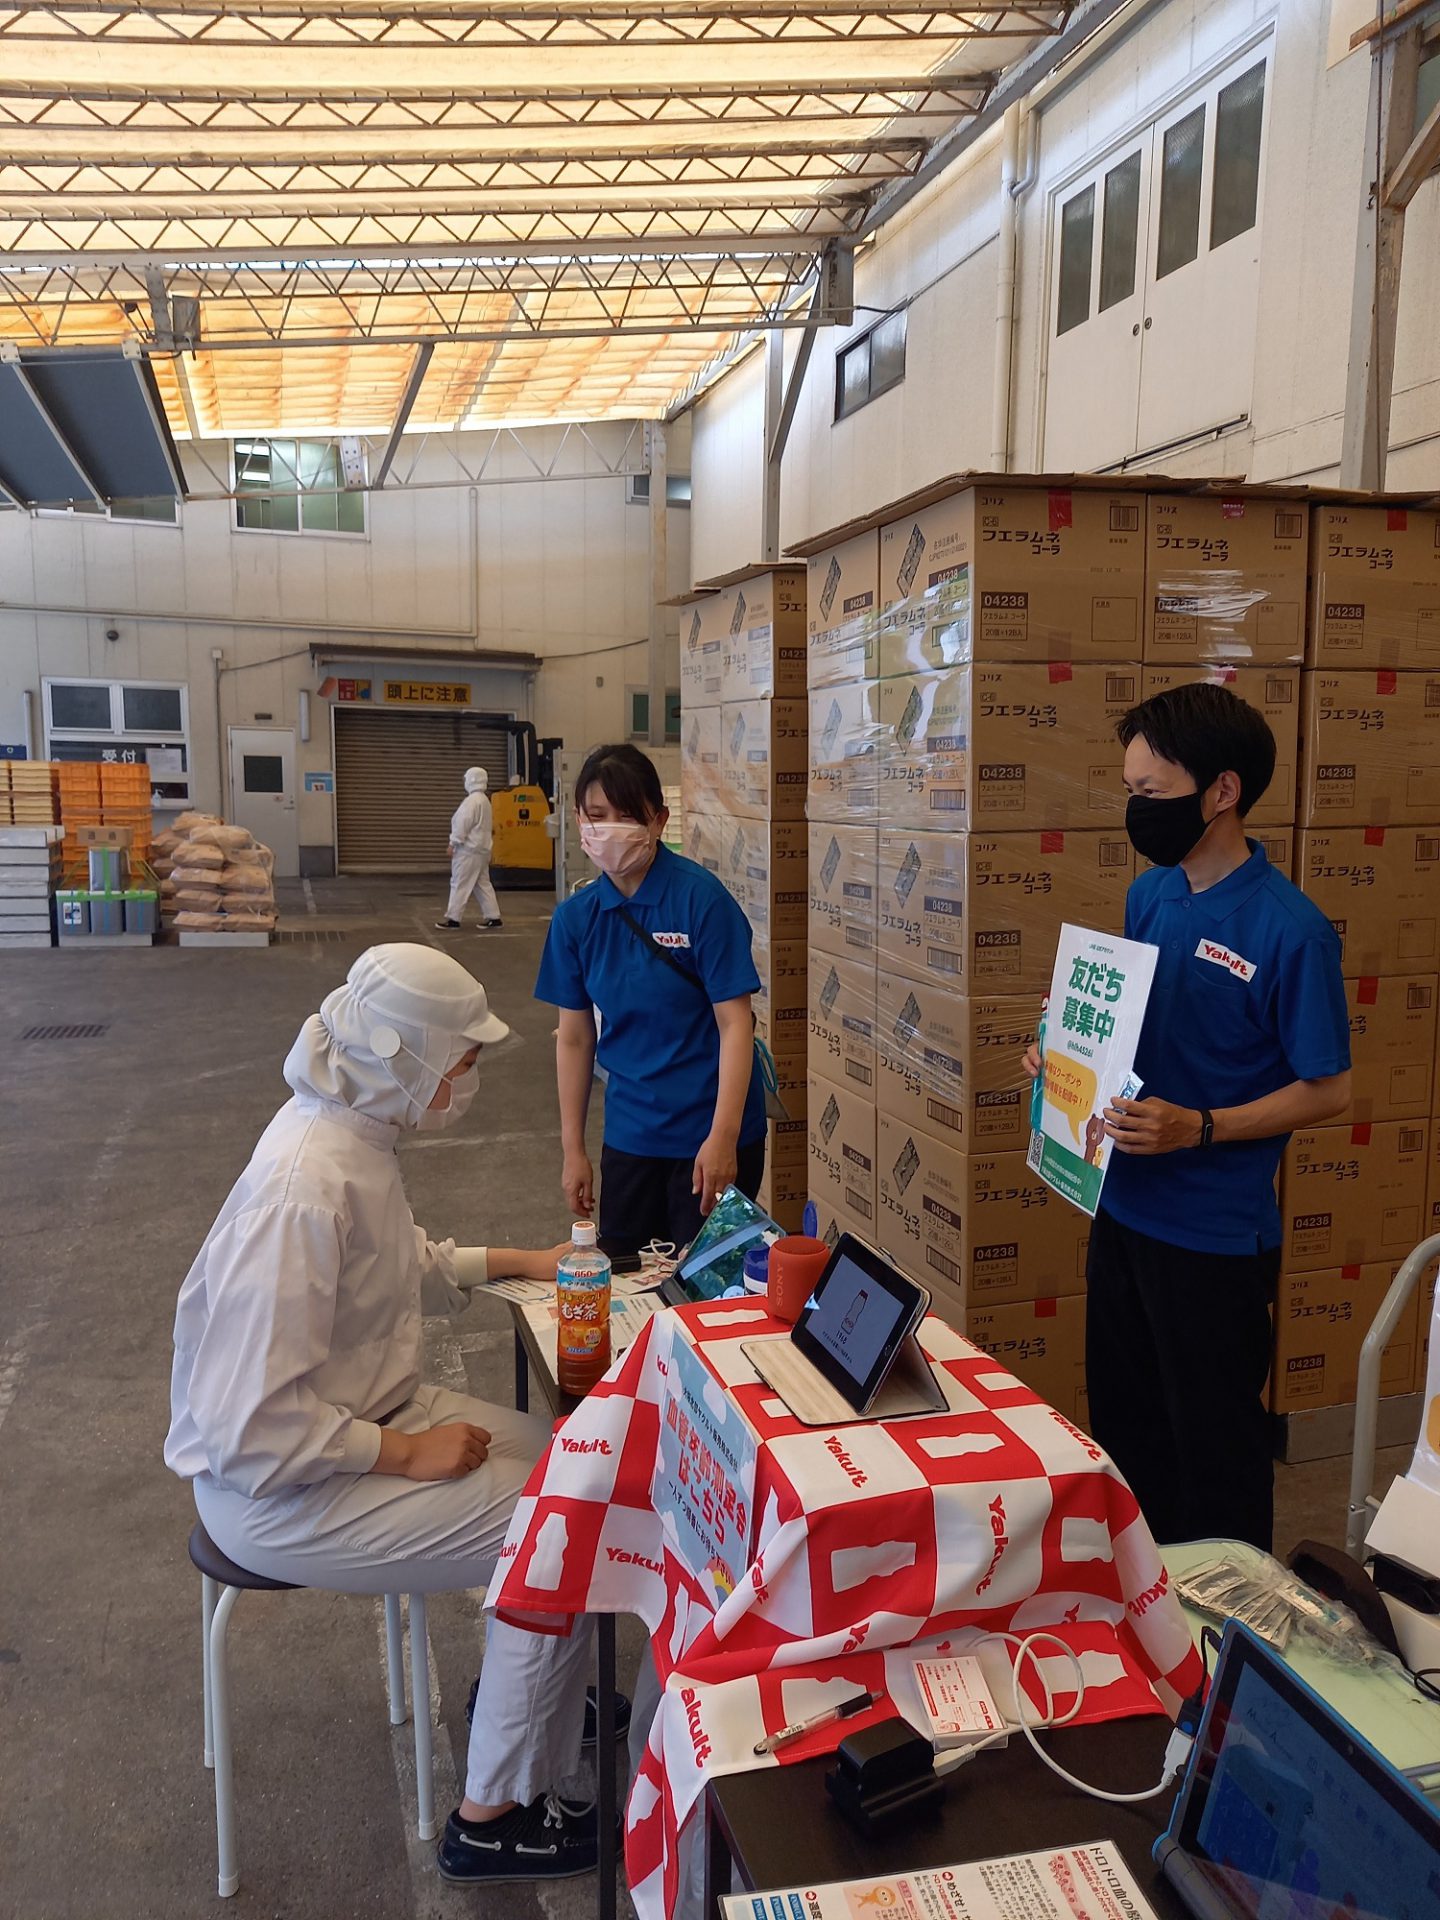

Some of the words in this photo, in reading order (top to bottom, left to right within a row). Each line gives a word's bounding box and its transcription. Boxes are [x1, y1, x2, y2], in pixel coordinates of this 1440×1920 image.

[981, 497, 1004, 506] コリス
[1156, 506, 1177, 514] コリス
[1328, 515, 1349, 524] コリス
[982, 530, 1060, 543] フエラムネ
[1031, 545, 1061, 555] コーラ
[1157, 538, 1229, 550] フエラムネ
[1202, 552, 1229, 561] コーラ
[1328, 546, 1393, 559] フエラムネ
[1369, 559, 1393, 569] コーラ
[984, 594, 1025, 607] 04238
[884, 607, 926, 627] フエラムネ
[1010, 612, 1026, 620] コーラ
[1327, 606, 1362, 617] 04238
[909, 623, 926, 636] コーラ
[810, 629, 841, 646] フエラムネ
[979, 674, 1002, 682] コリス
[1150, 676, 1171, 684] コリス
[387, 684, 468, 703] 頭上に注意
[980, 705, 1057, 716] フエラムネ
[1319, 709, 1384, 720] フエラムネ
[1029, 717, 1057, 727] コーラ
[1360, 721, 1384, 730] コーラ
[102, 749, 136, 763] 受付
[811, 769, 842, 780] フエラムネ
[883, 768, 924, 780] フエラムネ
[982, 768, 1023, 778] 04238
[1319, 767, 1353, 778] 04238
[830, 782, 842, 792] コーラ
[907, 782, 924, 792] コーラ
[975, 844, 998, 852] コリス
[1310, 866, 1375, 877] フエラムネ
[976, 872, 1052, 885] フエラムネ
[1351, 876, 1375, 886] コーラ
[1024, 883, 1052, 894] コーラ
[810, 899, 841, 915] フエラムネ
[932, 902, 953, 913] 04238
[829, 917, 841, 928] コーラ
[881, 915, 922, 934] フエラムネ
[905, 934, 921, 947] コーラ
[978, 934, 1018, 945] 04238
[1068, 955, 1126, 1002] 友だち
[975, 1006, 998, 1014] コリス
[1062, 996, 1115, 1044] 募集中
[809, 1022, 841, 1045] フエラムネ
[829, 1044, 841, 1057] コーラ
[880, 1056, 921, 1084] フエラムネ
[905, 1080, 921, 1096] コーラ
[978, 1093, 1018, 1105] 04238
[1296, 1137, 1316, 1145] コリス
[810, 1143, 841, 1173] フエラムネ
[974, 1162, 996, 1172] コリス
[1296, 1160, 1359, 1175] フエラムネ
[829, 1169, 841, 1184] コーラ
[1336, 1170, 1359, 1181] コーラ
[975, 1186, 1048, 1203] フエラムネ
[1022, 1197, 1048, 1208] コーラ
[881, 1192, 920, 1229] フエラムネ
[931, 1202, 952, 1223] 04238
[1296, 1216, 1329, 1229] 04238
[905, 1222, 920, 1240] コーラ
[976, 1246, 1015, 1260] 04238
[575, 1270, 592, 1278] 650
[776, 1264, 784, 1308] SONY
[1290, 1281, 1309, 1290] コリス
[561, 1302, 600, 1321] むぎ茶
[1290, 1301, 1352, 1319] フエラムネ
[973, 1315, 994, 1324] コリス
[1329, 1312, 1352, 1323] コーラ
[1020, 1348, 1046, 1359] コーラ
[1289, 1357, 1322, 1370] 04238
[1048, 1410, 1102, 1462] Yakult
[561, 1438, 613, 1455] Yakult
[824, 1435, 868, 1488] Yakult
[667, 1398, 747, 1541] 血管年齢測定会
[679, 1447, 724, 1545] はこちら
[975, 1493, 1008, 1597] Yakult
[606, 1547, 666, 1576] Yakul
[680, 1687, 712, 1768] akult
